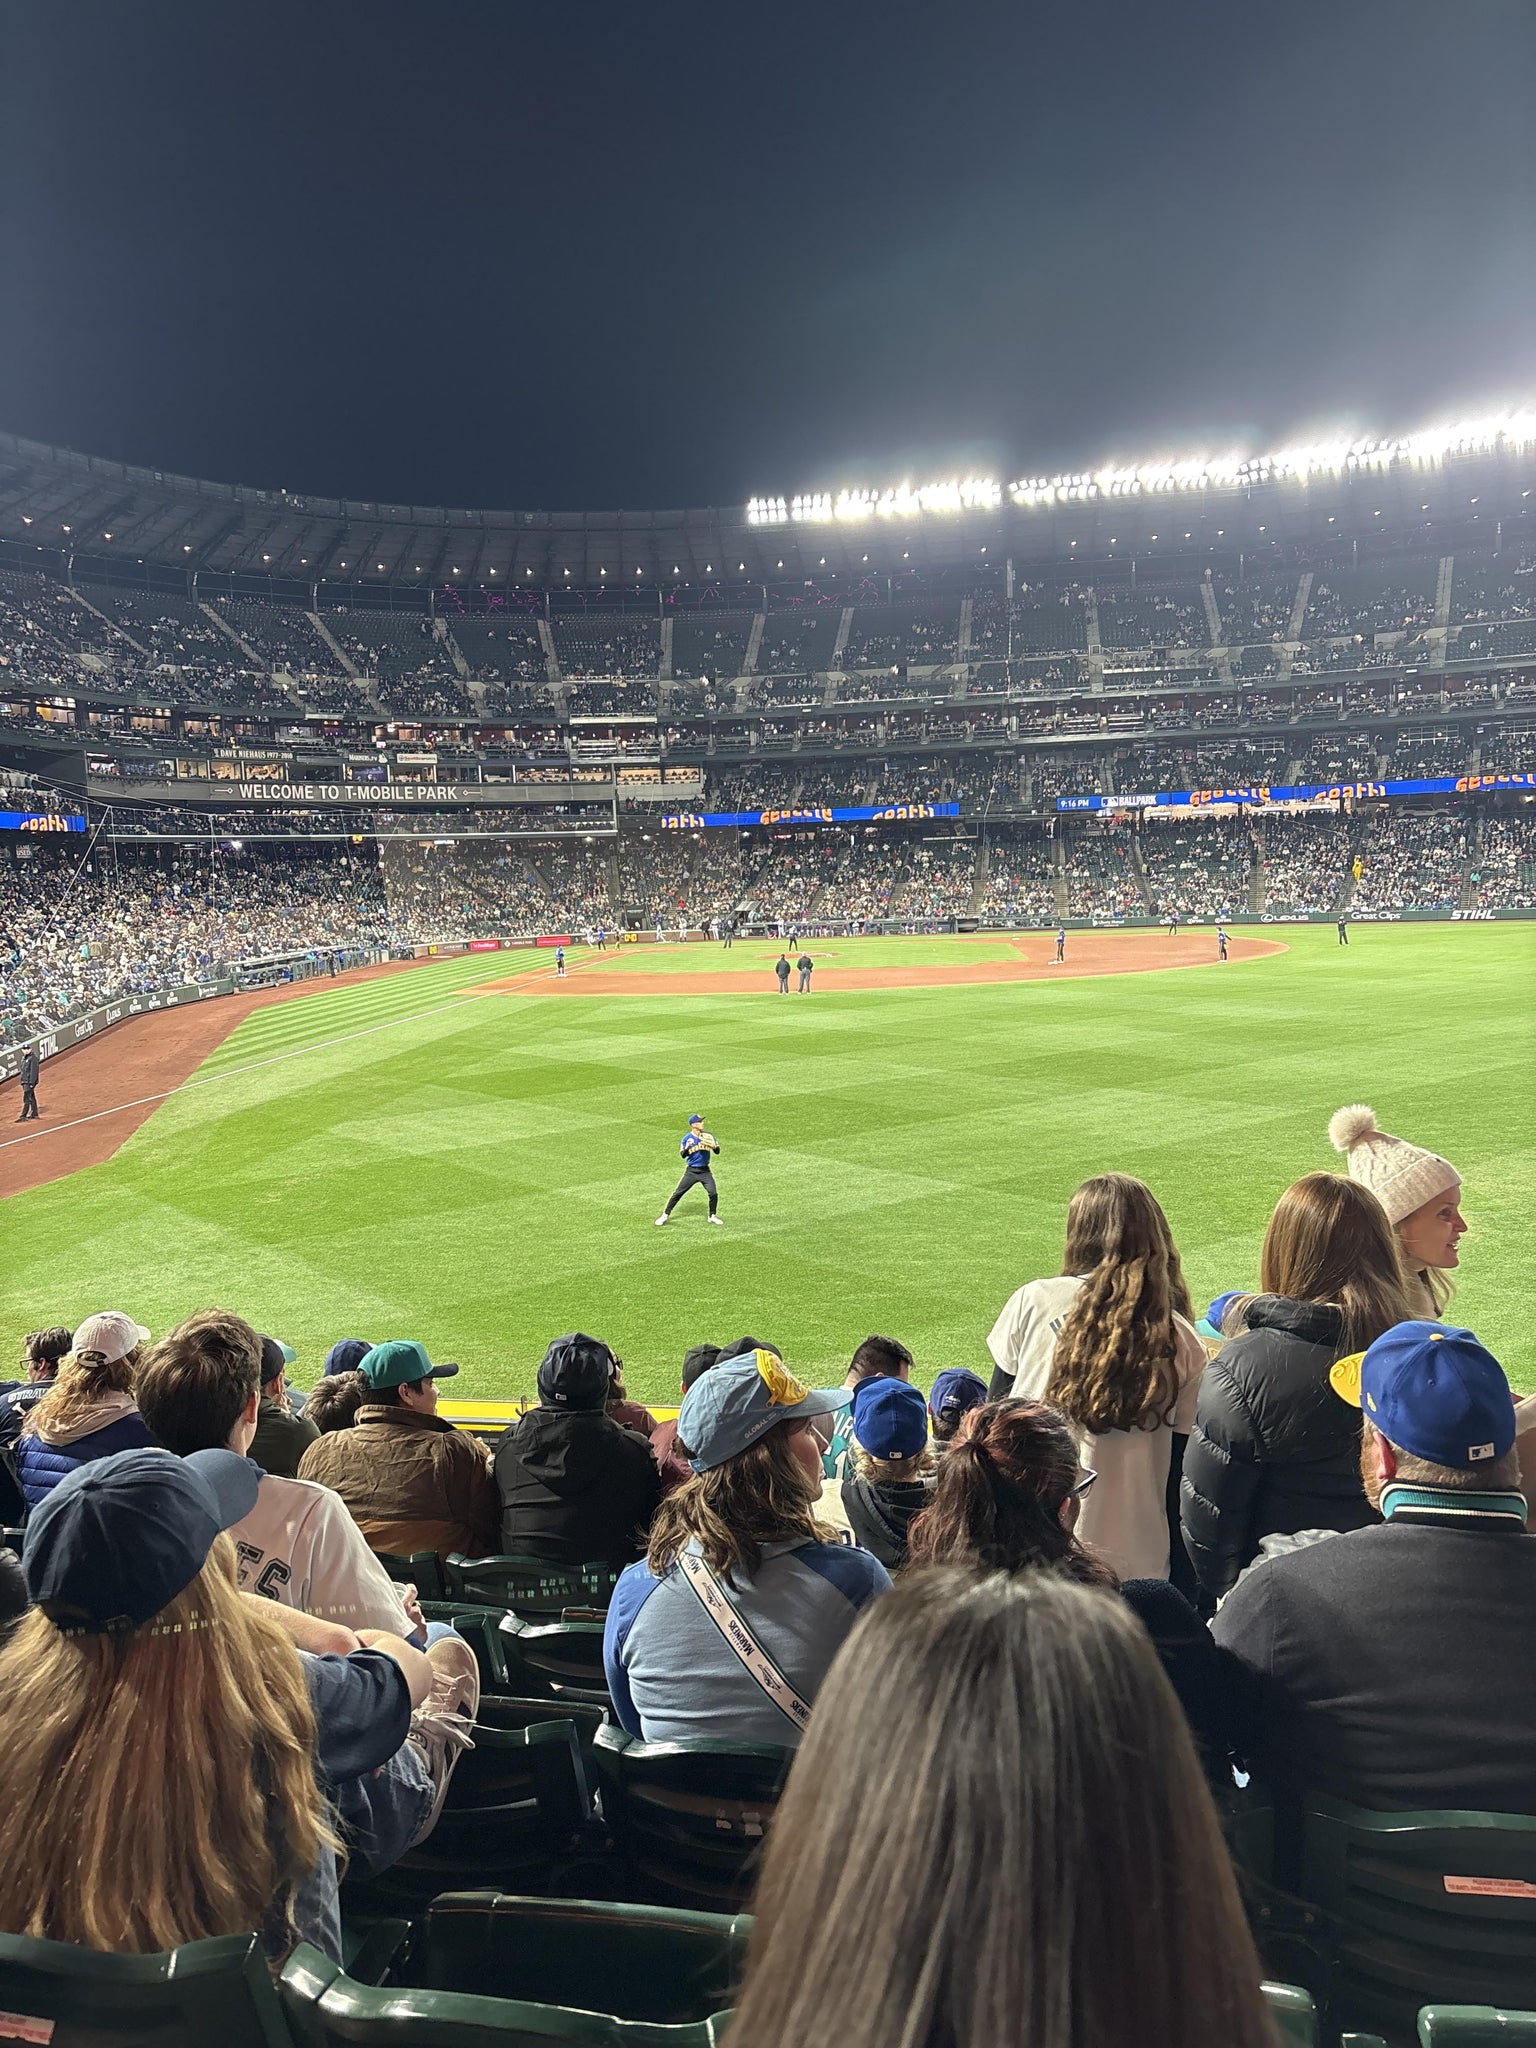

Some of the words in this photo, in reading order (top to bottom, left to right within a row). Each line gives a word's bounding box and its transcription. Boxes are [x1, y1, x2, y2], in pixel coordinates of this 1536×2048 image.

[220, 749, 237, 758] DAVE
[238, 750, 266, 759] NIEHAUS
[239, 783, 315, 799] WELCOME
[318, 785, 340, 800] TO
[344, 785, 414, 800] T-MOBILE
[417, 786, 458, 800] PARK
[1060, 800, 1077, 808] 9:16
[1077, 799, 1089, 807] PM
[1118, 795, 1156, 806] BALLPARK
[1351, 911, 1378, 920] Great
[1378, 911, 1402, 921] Clips
[1450, 909, 1496, 920] STIHL
[39, 1034, 59, 1061] STIHL
[744, 1418, 768, 1439] GLOBAL
[728, 1620, 755, 1656] MARINERS
